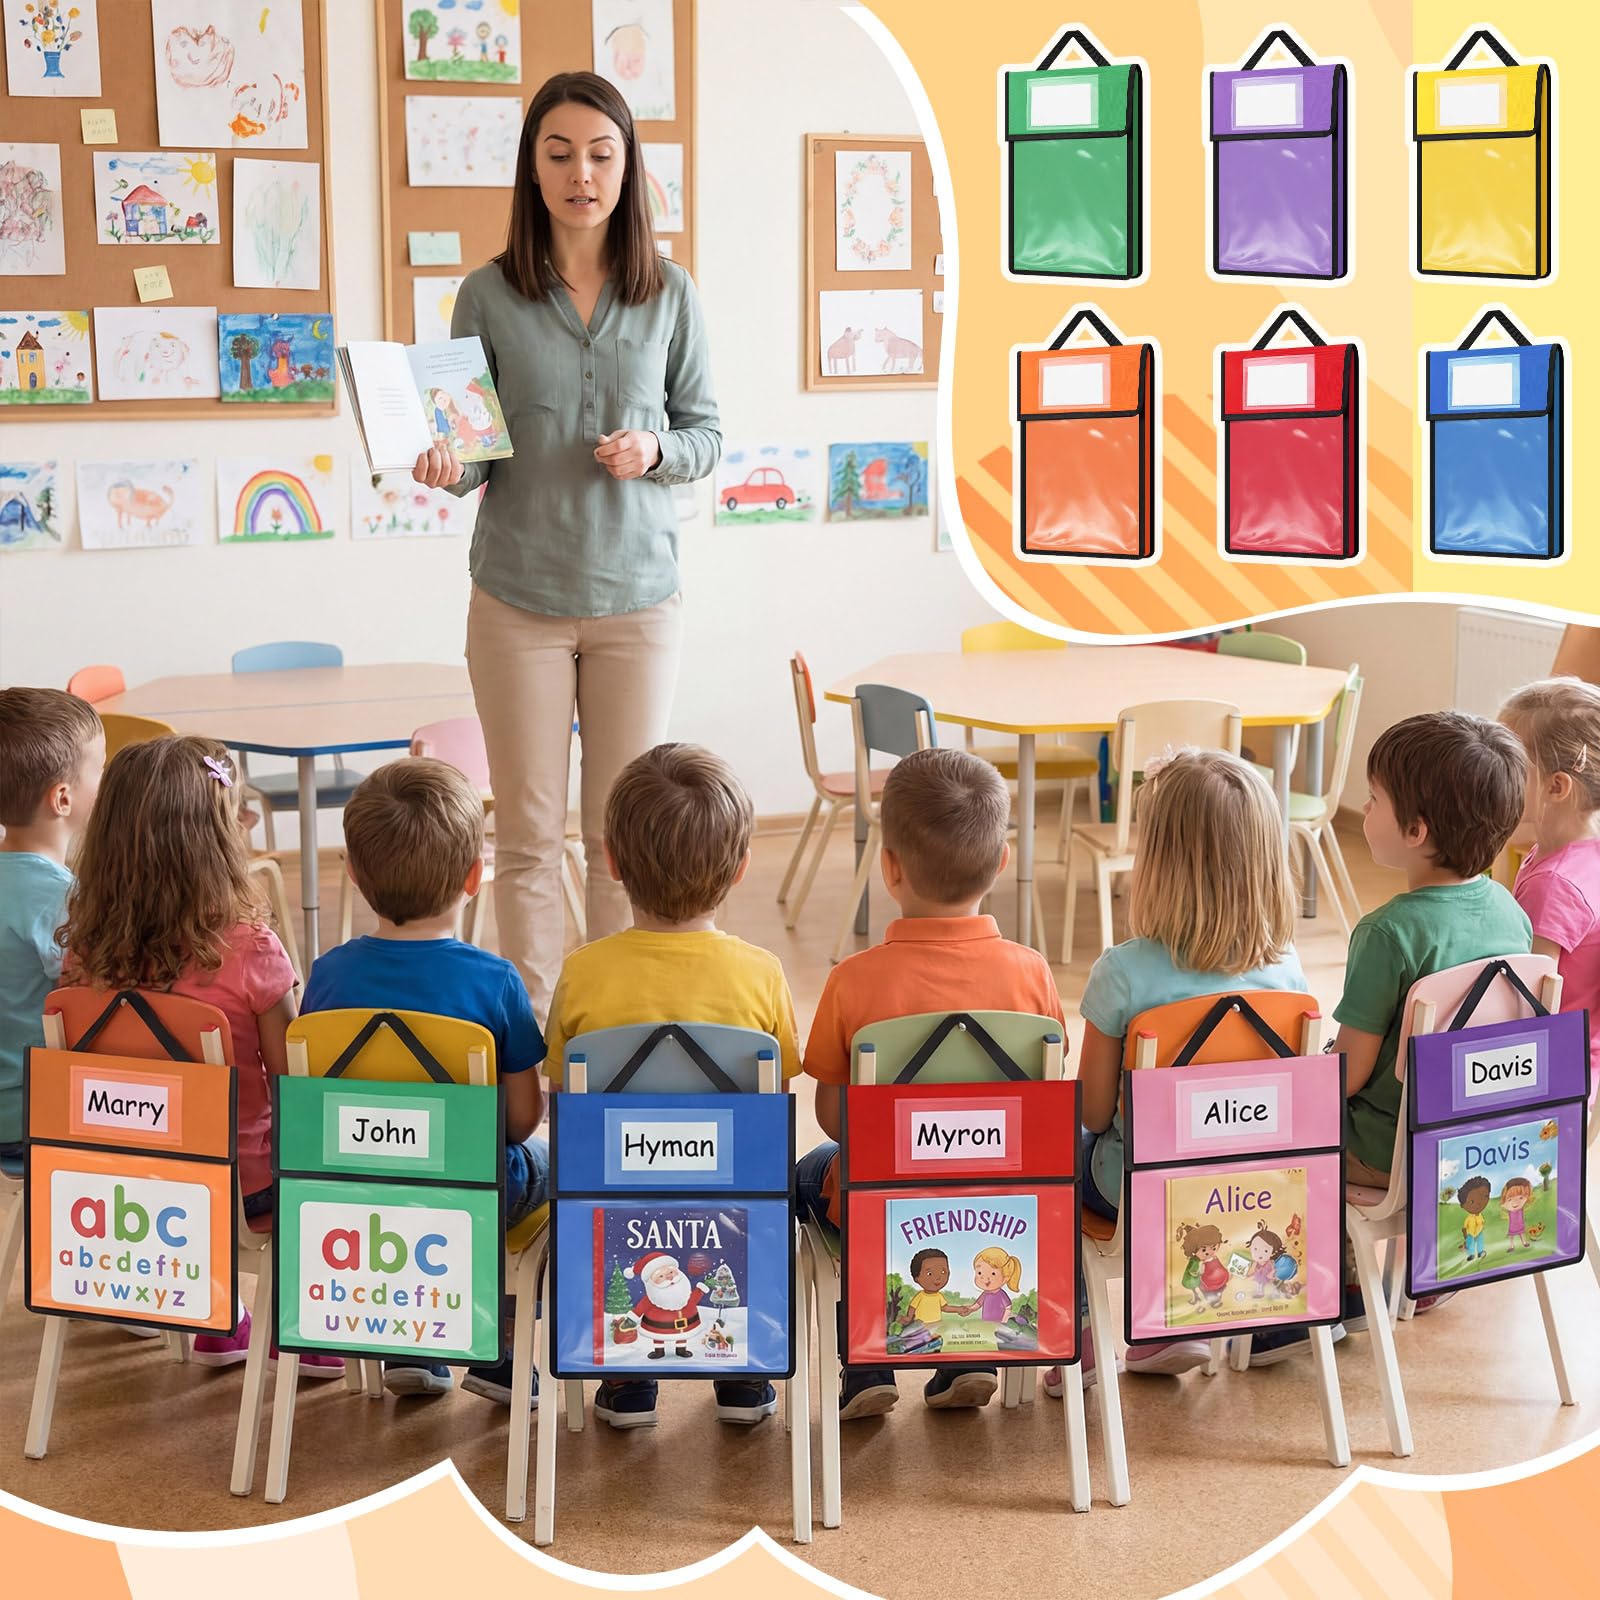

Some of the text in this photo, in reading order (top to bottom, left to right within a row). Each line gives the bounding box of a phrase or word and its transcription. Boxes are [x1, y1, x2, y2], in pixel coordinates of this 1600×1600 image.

[1472, 1058, 1534, 1084] Davis
[87, 1090, 165, 1126] Marry
[1204, 1099, 1269, 1125] Alice
[352, 1118, 416, 1145] John
[917, 1122, 1001, 1154] Myron
[625, 1133, 714, 1165] Hyman
[1465, 1140, 1531, 1170] Davis
[70, 1184, 188, 1248] abc
[1205, 1186, 1273, 1215] Alice
[626, 1217, 723, 1249] SANTA
[900, 1209, 1028, 1245] FRIENDSHIP
[321, 1213, 449, 1276] abc
